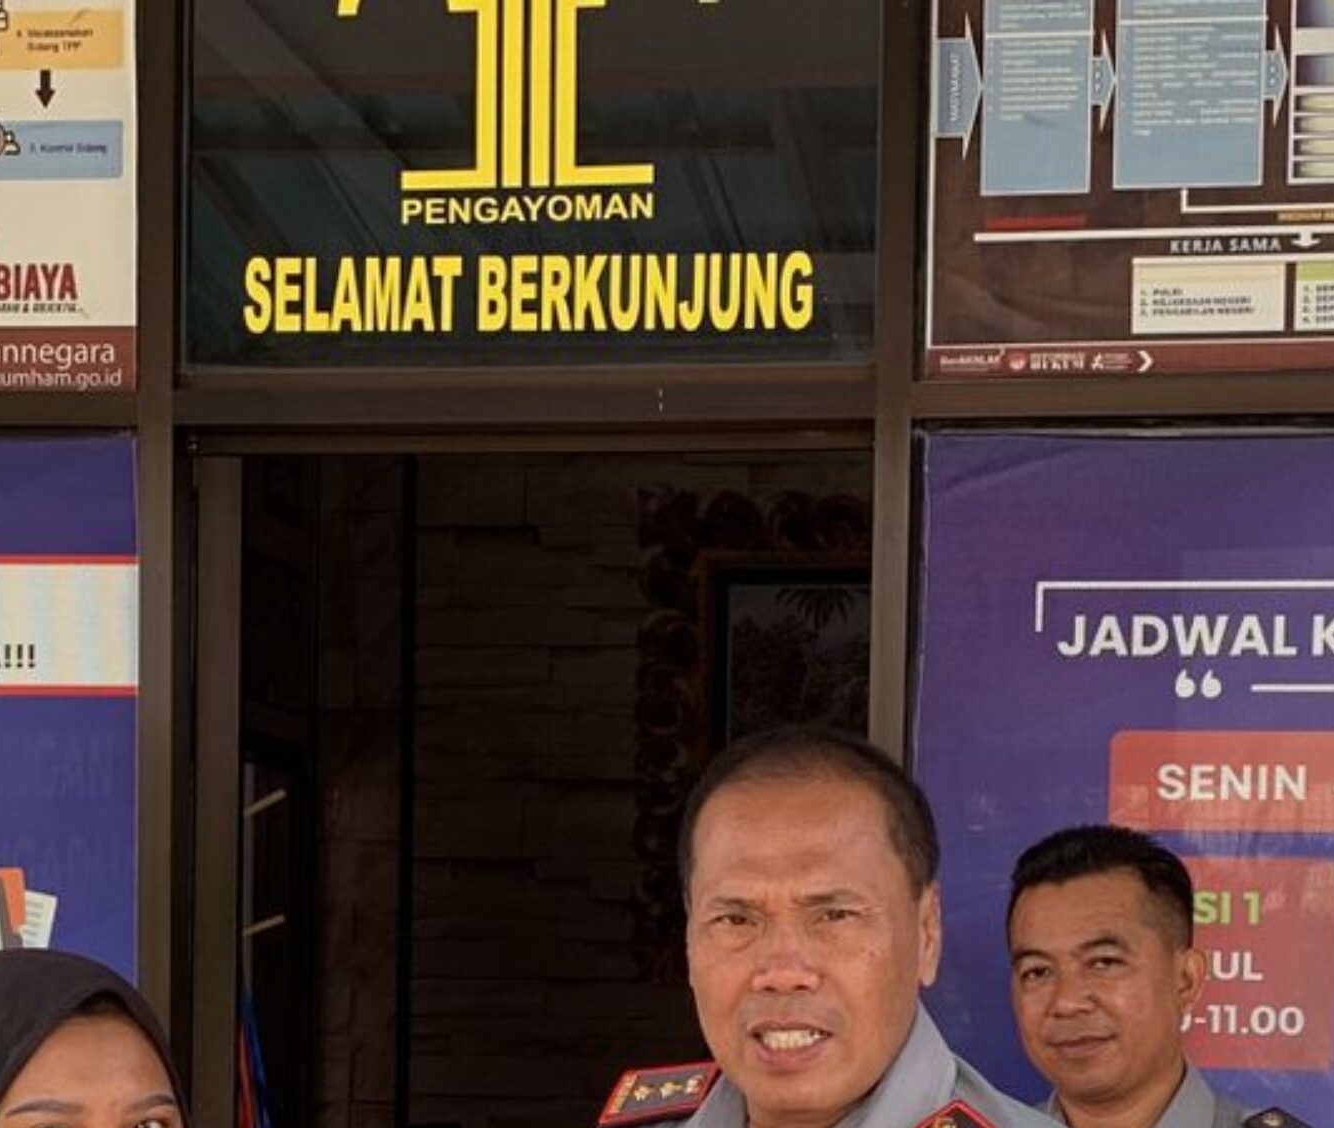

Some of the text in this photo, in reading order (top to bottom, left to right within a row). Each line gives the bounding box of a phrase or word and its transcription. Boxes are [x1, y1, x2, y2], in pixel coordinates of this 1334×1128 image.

[401, 192, 653, 225] PENGAYOMAN
[1170, 240, 1223, 254] KERJA
[1228, 238, 1281, 252] SAMA
[244, 251, 813, 333] SELAMAT BERKUNJUNG
[1058, 615, 1297, 656] JADWAL
[1158, 765, 1306, 801] SENIN
[1243, 891, 1259, 924] 1
[1207, 952, 1264, 980] UL
